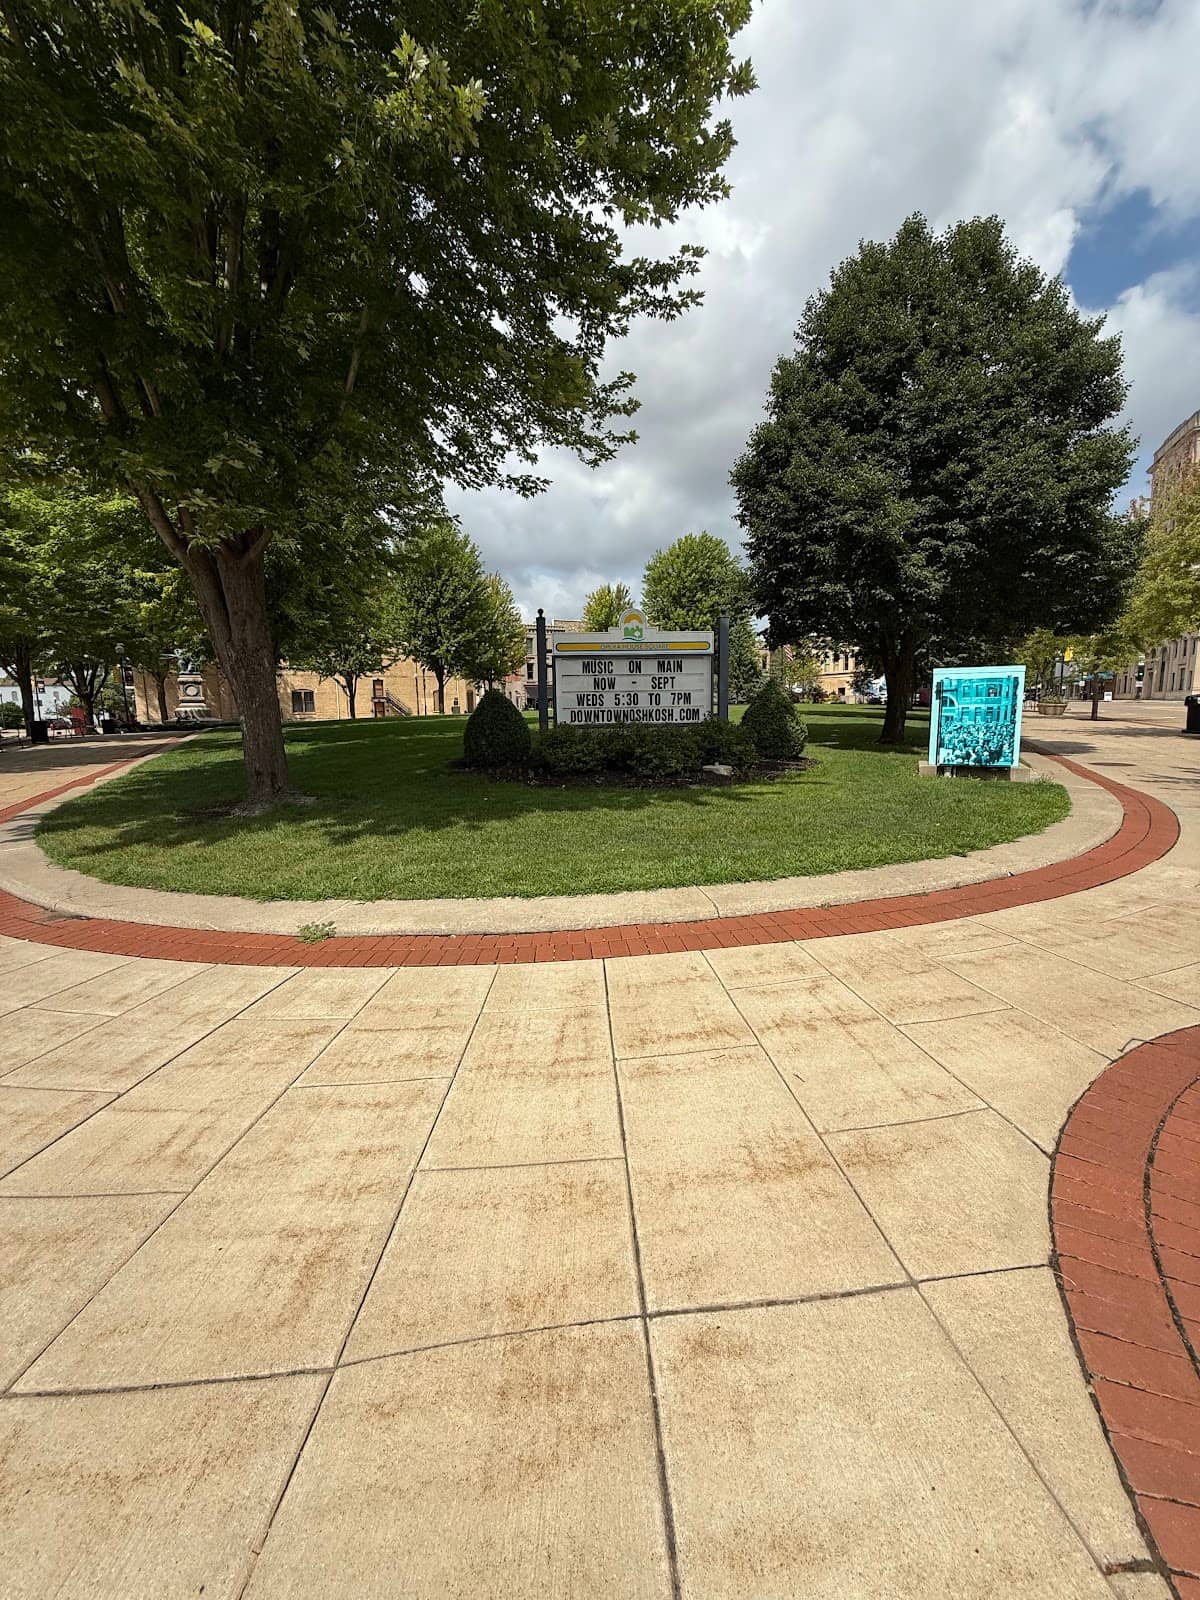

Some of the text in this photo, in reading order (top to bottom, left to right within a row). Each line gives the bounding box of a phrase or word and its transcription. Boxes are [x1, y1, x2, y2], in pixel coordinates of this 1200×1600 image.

[582, 660, 683, 674] MUSIC ON MAIN
[593, 677, 616, 690] NOW
[651, 676, 676, 689] SEPT
[576, 692, 692, 706] WEDS 5:30 TO 7PM
[570, 708, 700, 723] DOWNTOWNOSHKOSH.COM
